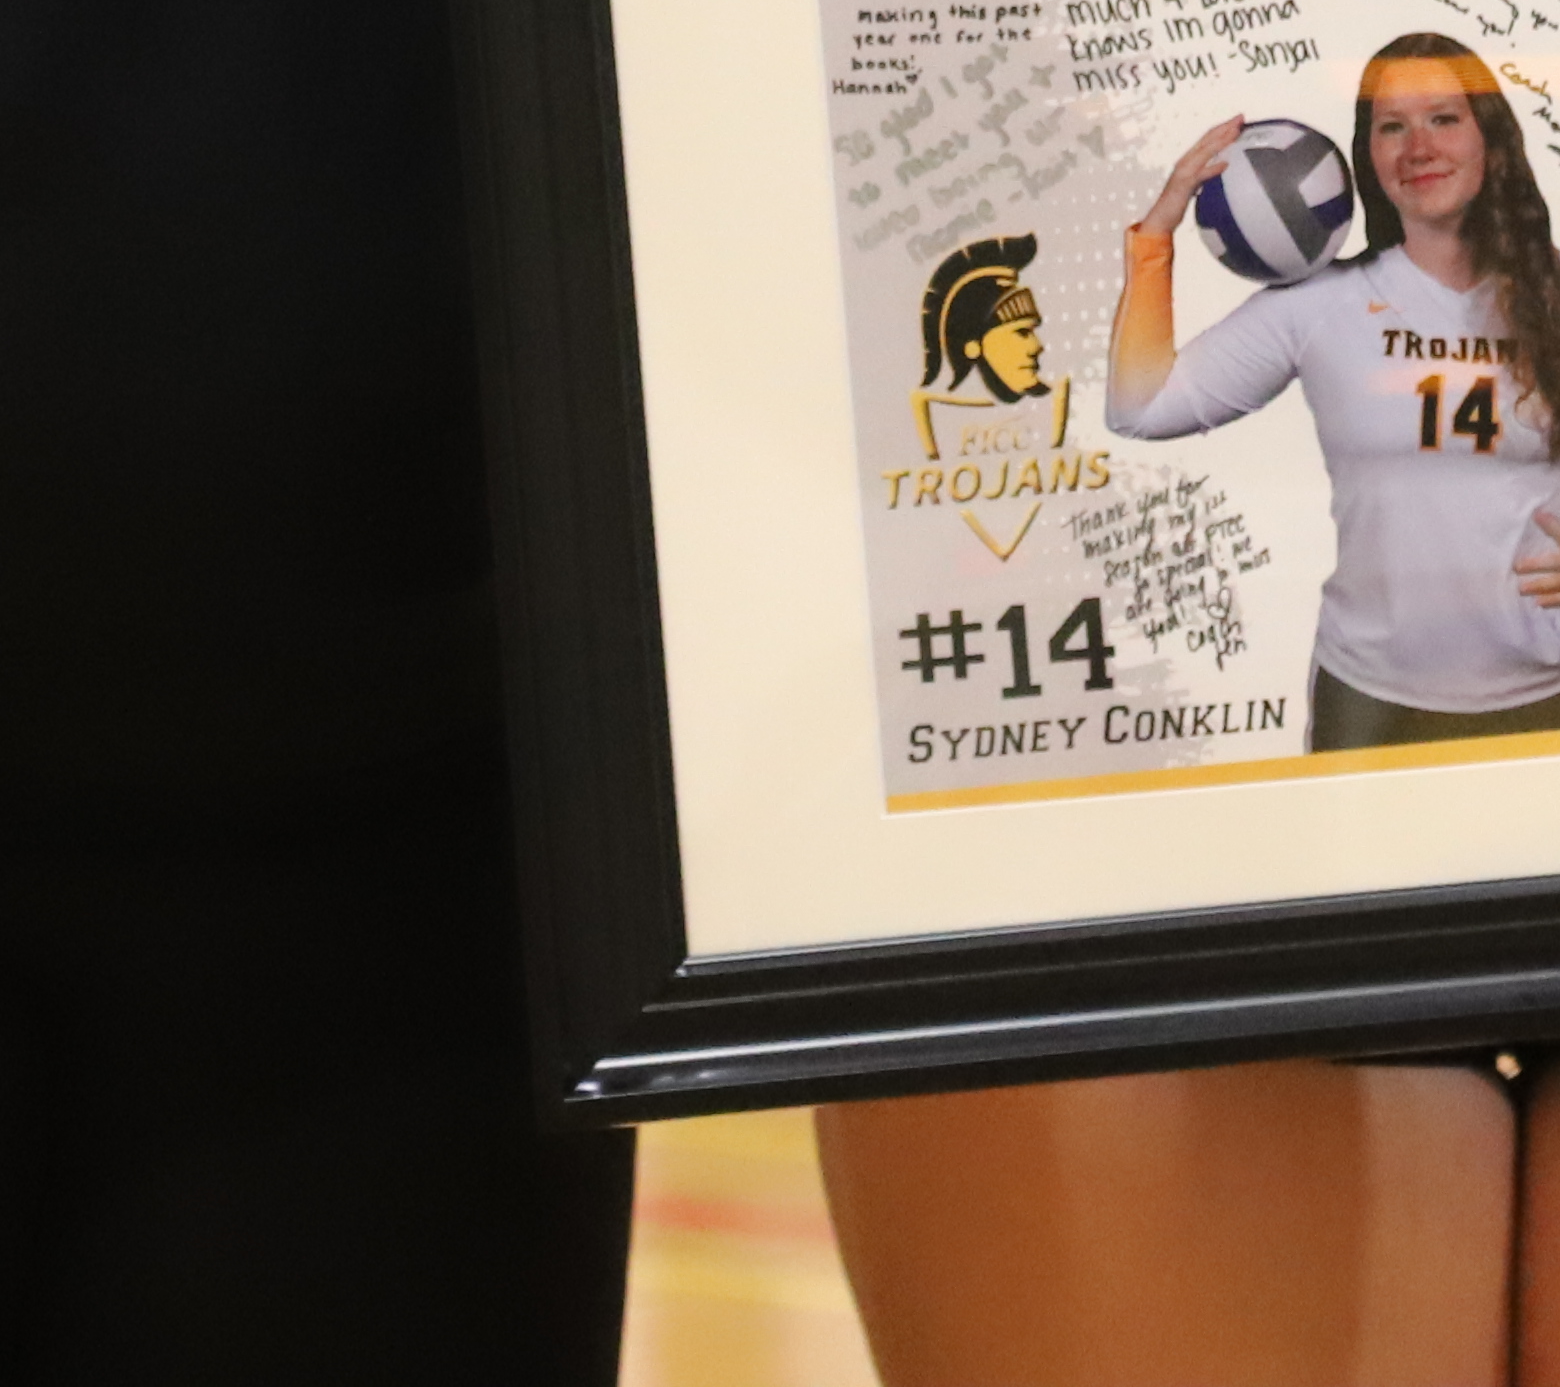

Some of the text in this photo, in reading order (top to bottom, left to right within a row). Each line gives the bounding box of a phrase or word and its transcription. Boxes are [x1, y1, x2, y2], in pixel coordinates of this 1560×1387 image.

[858, 3, 1042, 30] making this past
[853, 28, 1032, 50] year one for the
[1066, 28, 1152, 62] knows
[833, 80, 907, 95] Hannah
[1073, 63, 1141, 91] miss
[1154, 53, 1219, 94] you!
[1415, 373, 1505, 454] 14
[880, 450, 1111, 509] TROJANS
[898, 596, 1115, 700] #14
[908, 698, 1287, 764] SYDNEY CONKLIN
